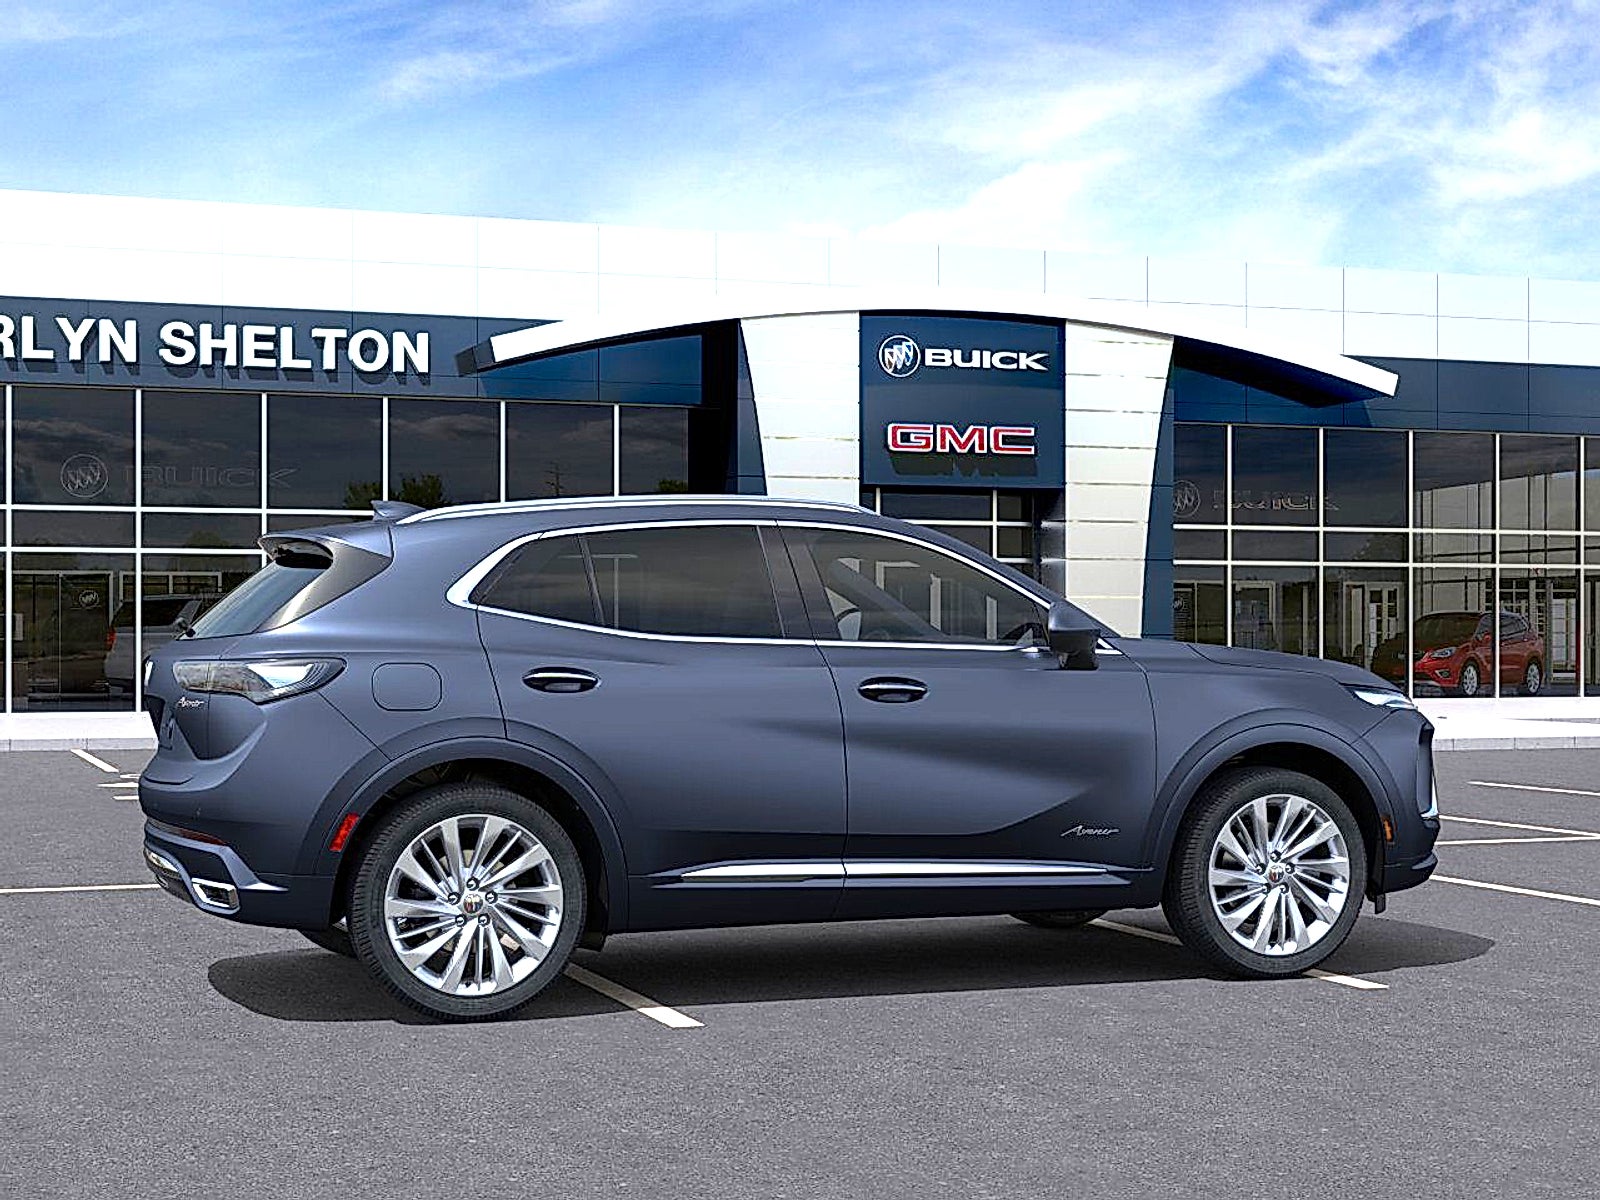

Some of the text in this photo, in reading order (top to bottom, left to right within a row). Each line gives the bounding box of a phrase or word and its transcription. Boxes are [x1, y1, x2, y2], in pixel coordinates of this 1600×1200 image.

[158, 321, 430, 374] SHELTON
[924, 348, 1049, 371] BUICK
[887, 423, 1035, 454] GMC
